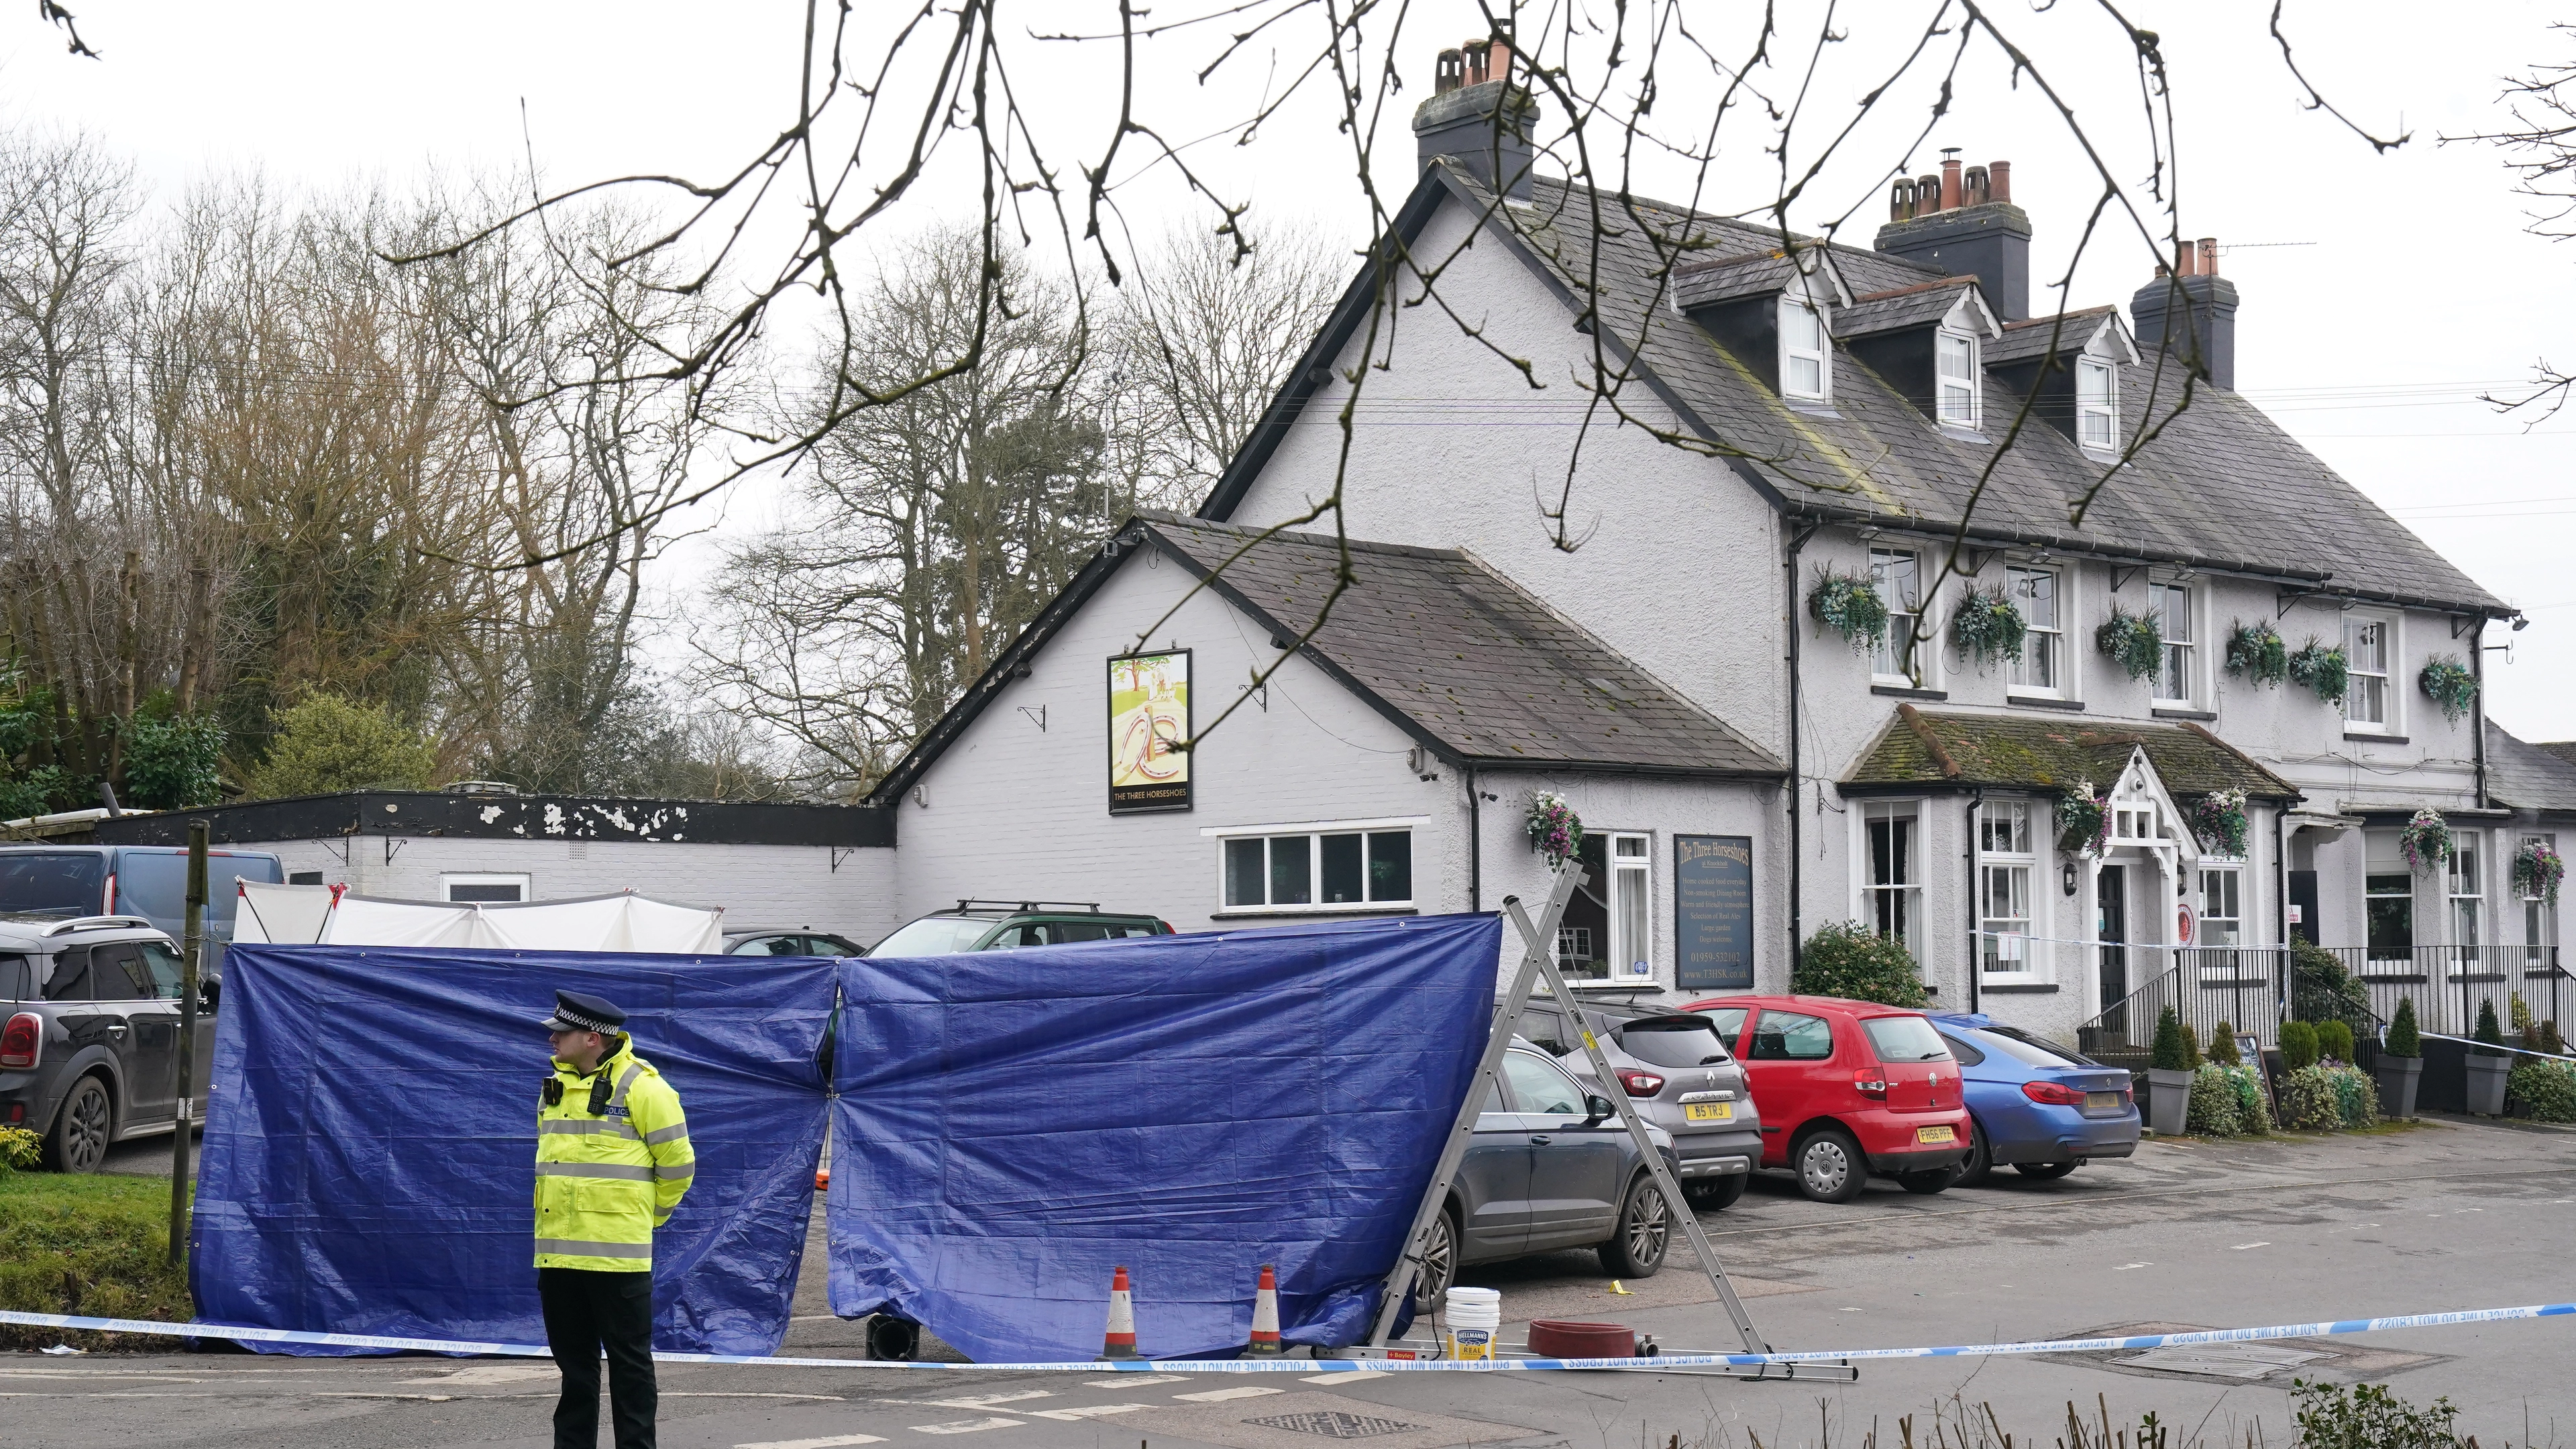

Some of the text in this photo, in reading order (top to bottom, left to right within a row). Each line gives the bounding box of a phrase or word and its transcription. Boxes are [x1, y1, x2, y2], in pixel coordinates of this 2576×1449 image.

[1127, 792, 1145, 800] THREE
[1146, 788, 1187, 798] HORSESHOES
[1680, 841, 1749, 866] The Three Horseshoes
[1717, 890, 1732, 898] Dining
[1705, 901, 1723, 909] friendly
[1701, 924, 1731, 932] Large garden
[1699, 936, 1711, 944] Dogs
[1690, 952, 1740, 962] 01959-532102
[1684, 969, 1748, 979] www.T3HSK.co.uk
[604, 1107, 629, 1116] POLICE
[1707, 1104, 1723, 1116] TRJ
[1920, 1129, 1939, 1140] FH56
[1244, 1362, 1267, 1371] LINE
[1271, 1362, 1307, 1371] POLICE
[1366, 1360, 1509, 1371] POLICE LINE DO NOT CROSS
